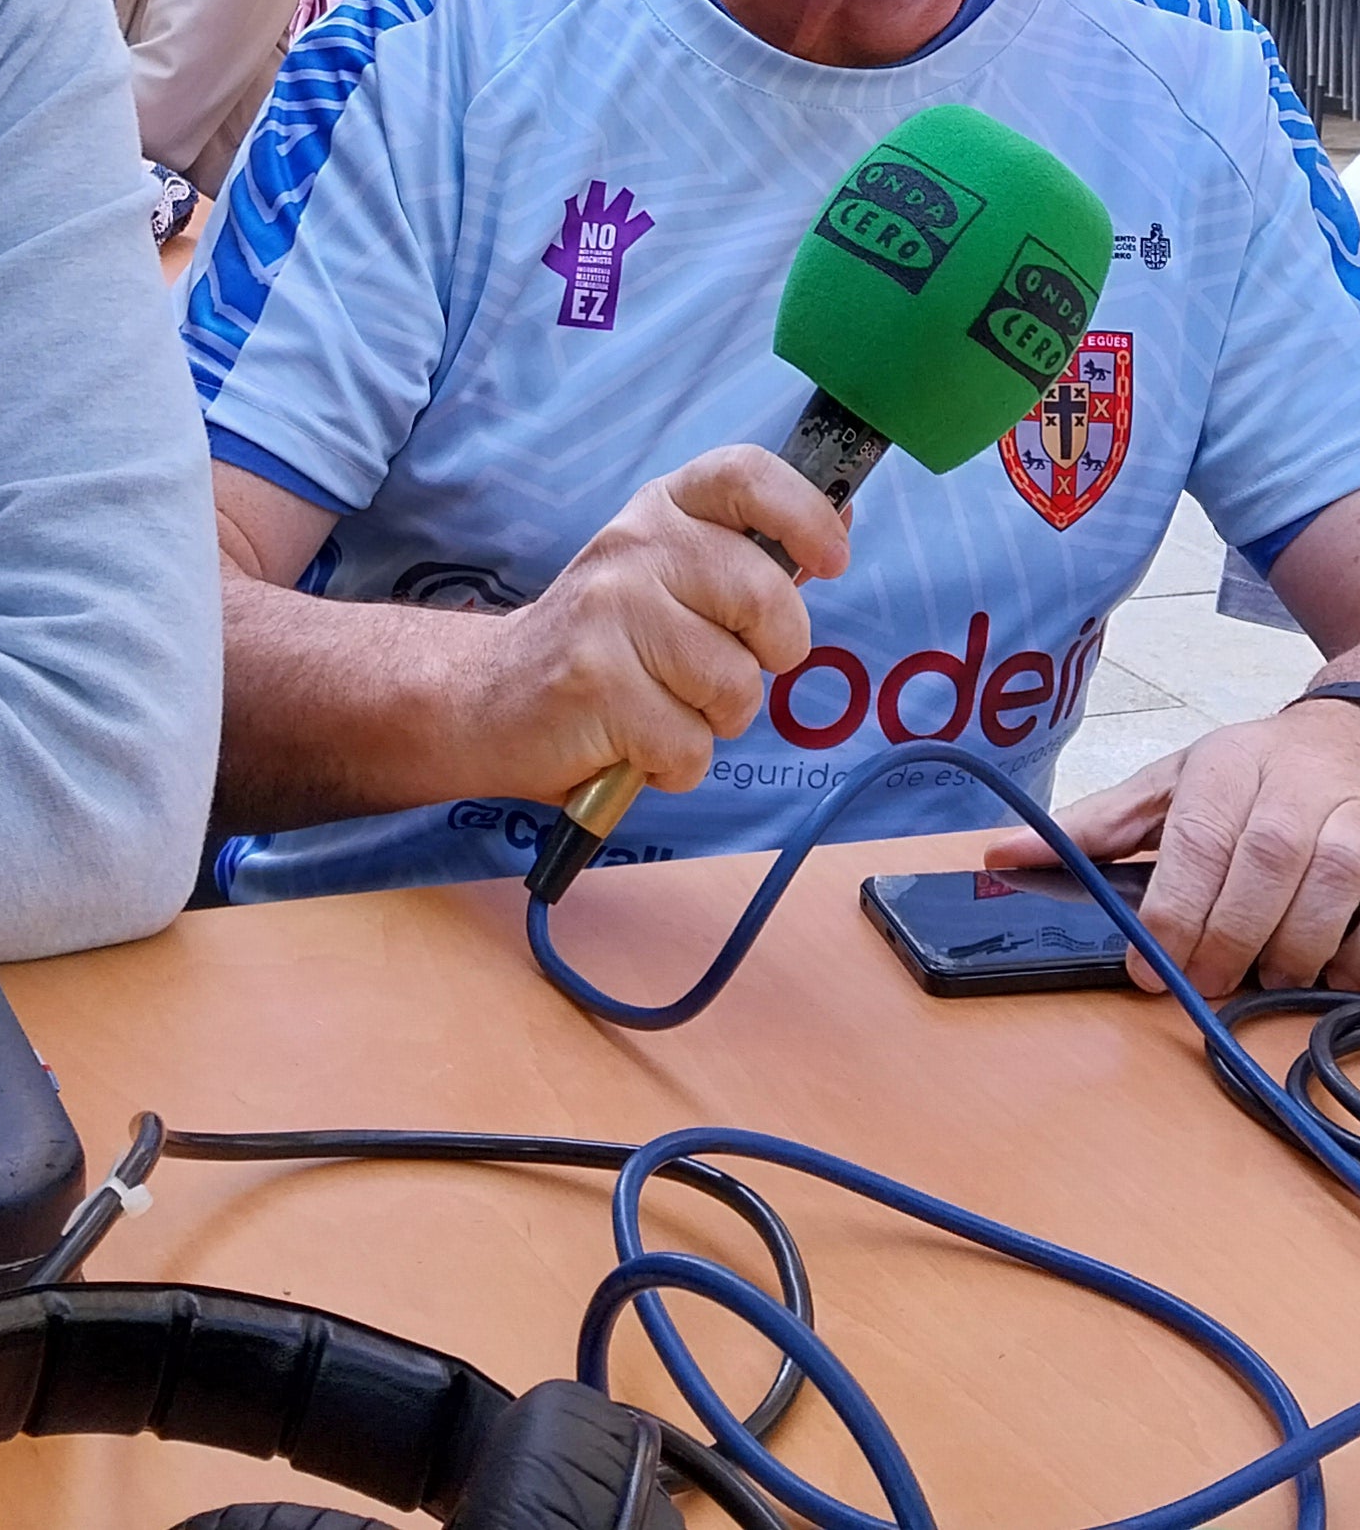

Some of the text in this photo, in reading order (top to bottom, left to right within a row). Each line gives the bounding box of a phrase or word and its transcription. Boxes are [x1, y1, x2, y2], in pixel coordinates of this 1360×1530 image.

[865, 165, 947, 221] ONDA
[579, 221, 617, 250] NO
[838, 201, 927, 260] CERO
[570, 288, 609, 323] EZ
[1024, 270, 1084, 337] ONDA
[1002, 313, 1066, 374] CERO
[886, 764, 925, 789] de
